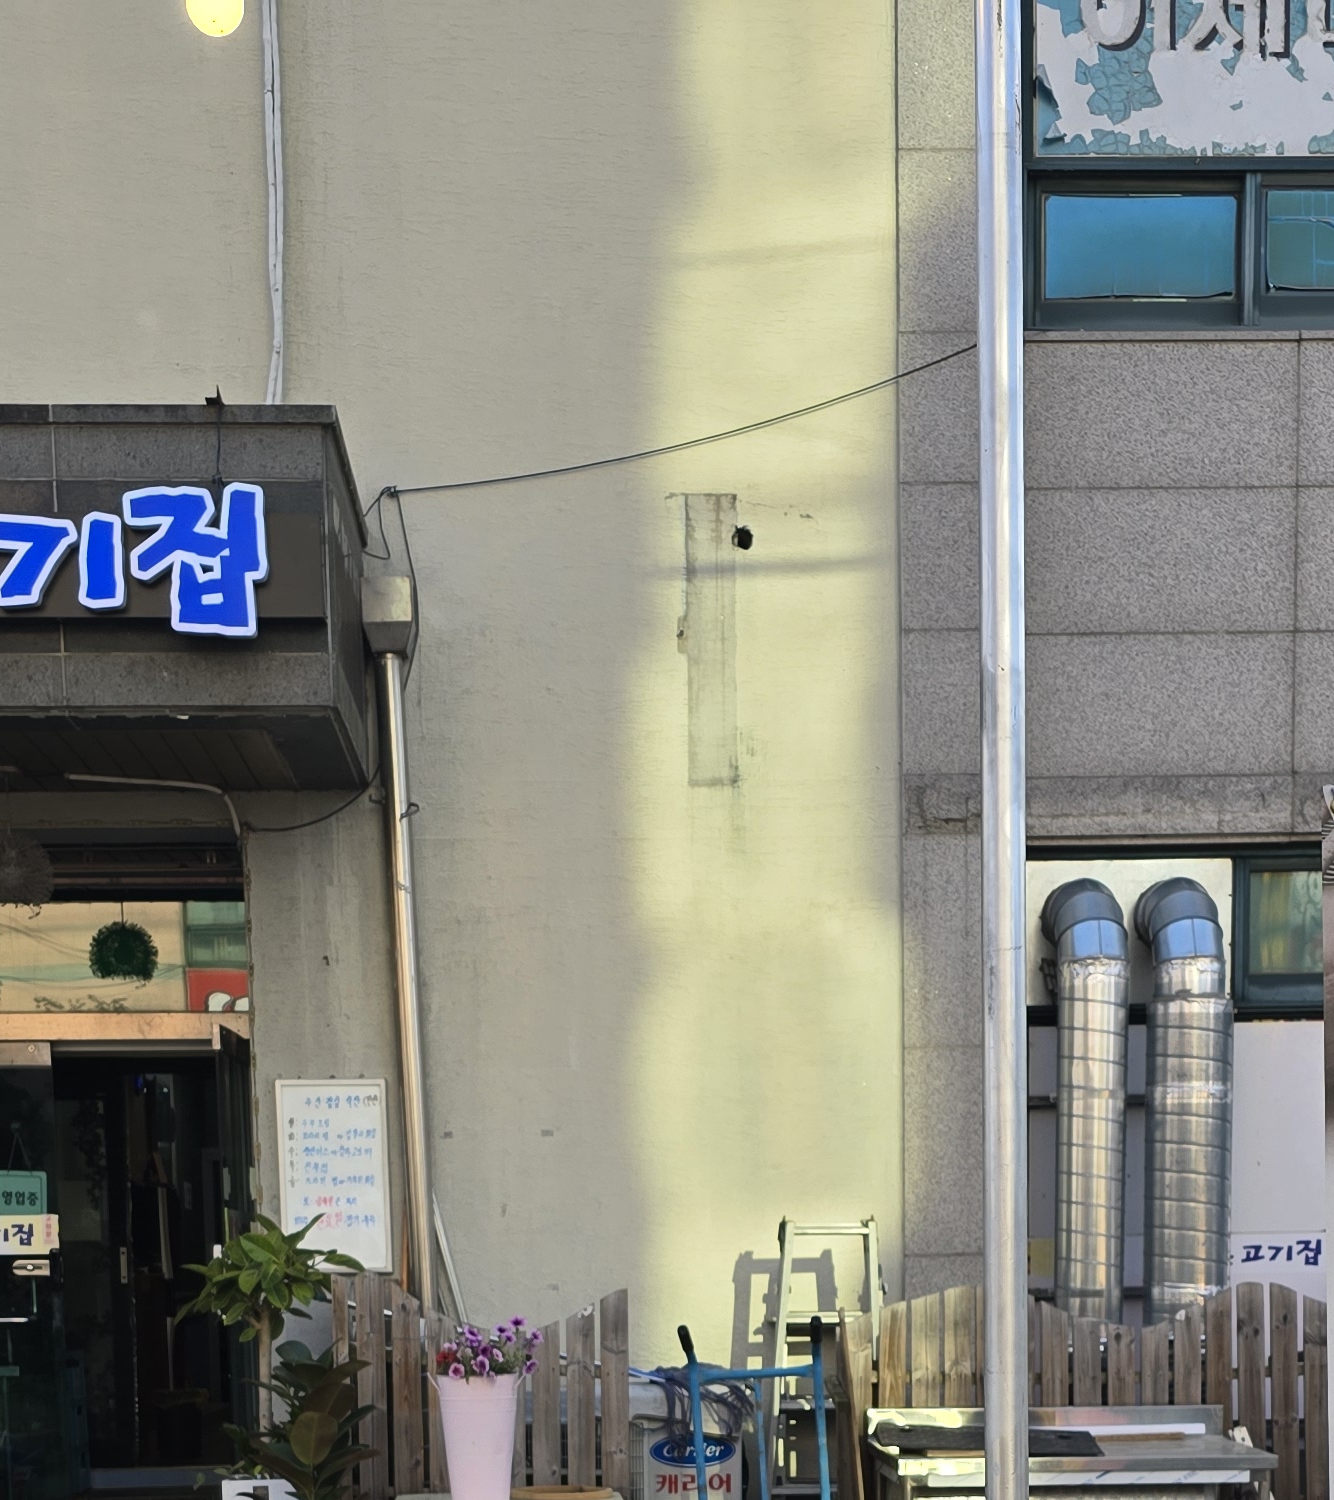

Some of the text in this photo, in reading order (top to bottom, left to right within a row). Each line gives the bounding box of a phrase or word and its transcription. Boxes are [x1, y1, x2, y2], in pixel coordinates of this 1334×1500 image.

[2, 1190, 38, 1207] 영업중
[1240, 1238, 1323, 1267] 고기집
[655, 1473, 732, 1494] 캐리어
